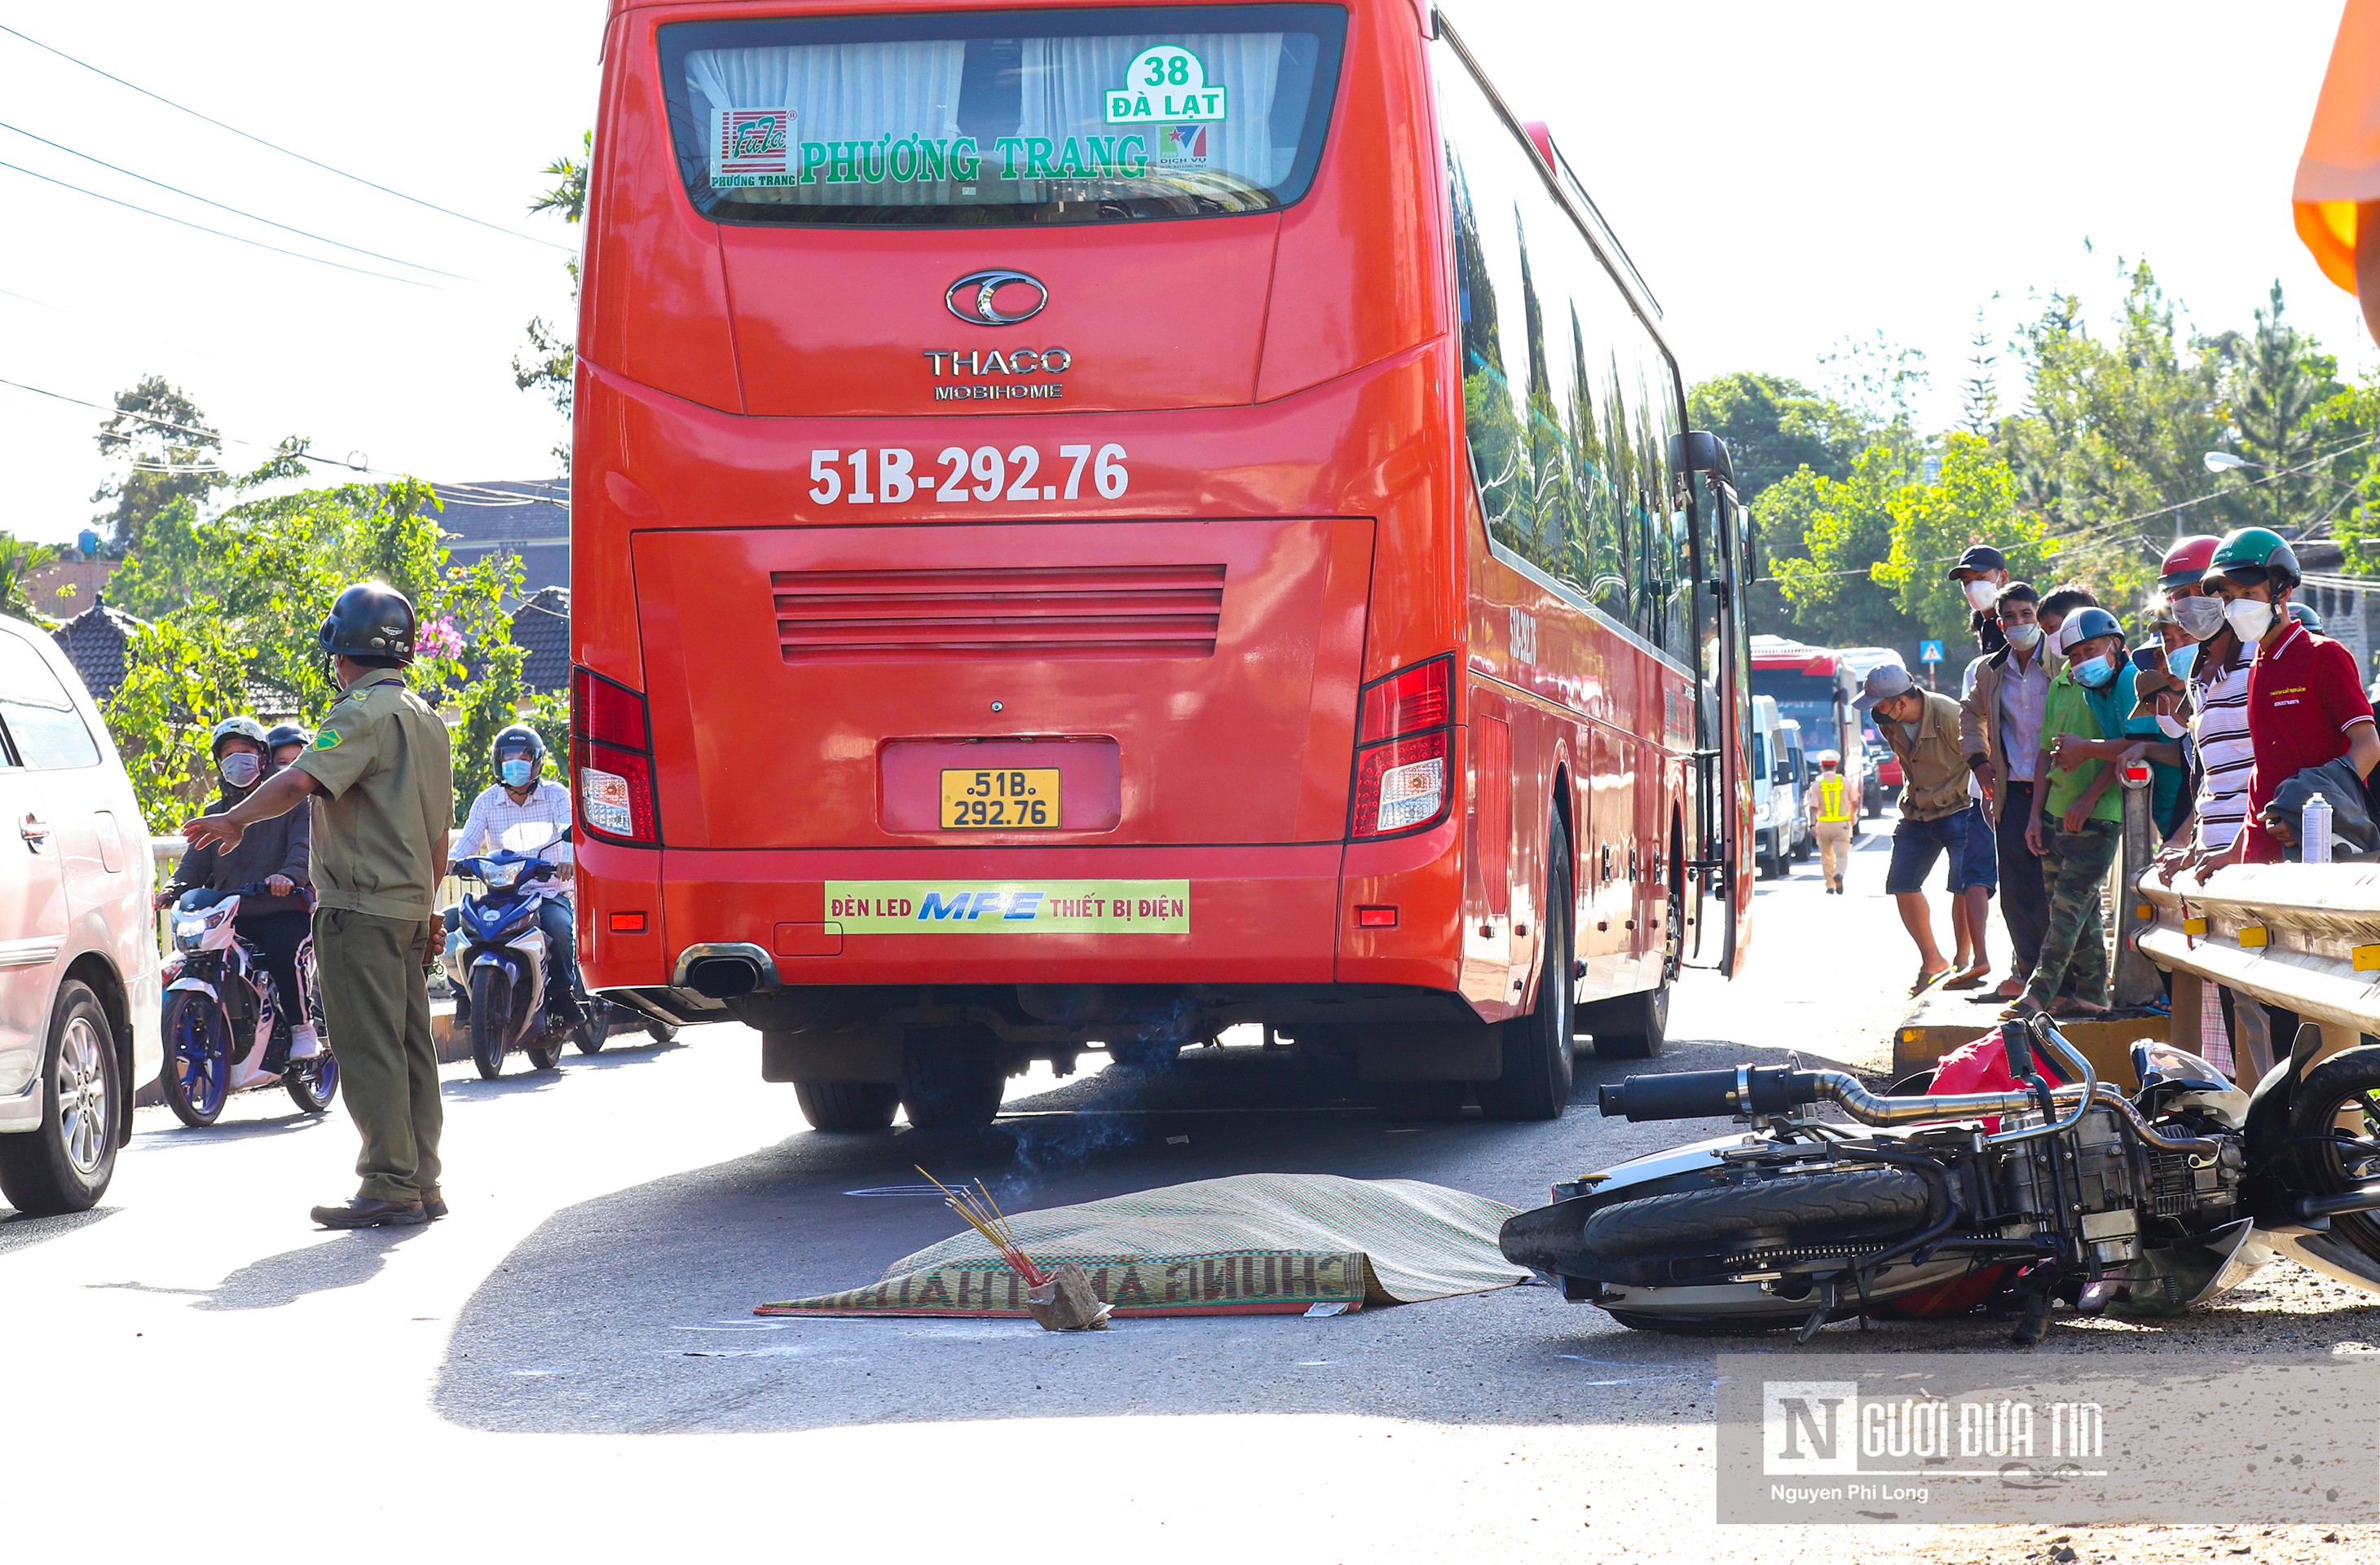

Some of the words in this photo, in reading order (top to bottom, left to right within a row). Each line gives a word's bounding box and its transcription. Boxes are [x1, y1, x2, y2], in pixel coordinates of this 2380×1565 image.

[1144, 55, 1189, 86] 38
[1112, 91, 1152, 117] ĐÀ
[1165, 94, 1219, 119] LẠT
[800, 130, 982, 184] PHƯƠNG
[994, 134, 1149, 181] TRANG
[712, 174, 756, 187] PHƯƠNG
[760, 174, 796, 187] TRANG
[923, 348, 1072, 377] THACO
[934, 383, 1063, 401] MOBIHOME
[809, 443, 1129, 505] 51B-292.76
[974, 772, 1026, 797] 51B
[954, 800, 1047, 826] 292.76
[831, 894, 870, 917] ĐÈN
[875, 899, 911, 917] LED
[916, 892, 1045, 921] MPE
[1050, 893, 1106, 918] THIẾT
[1113, 899, 1132, 923] BỊ
[1138, 899, 1183, 923] ĐIỆN
